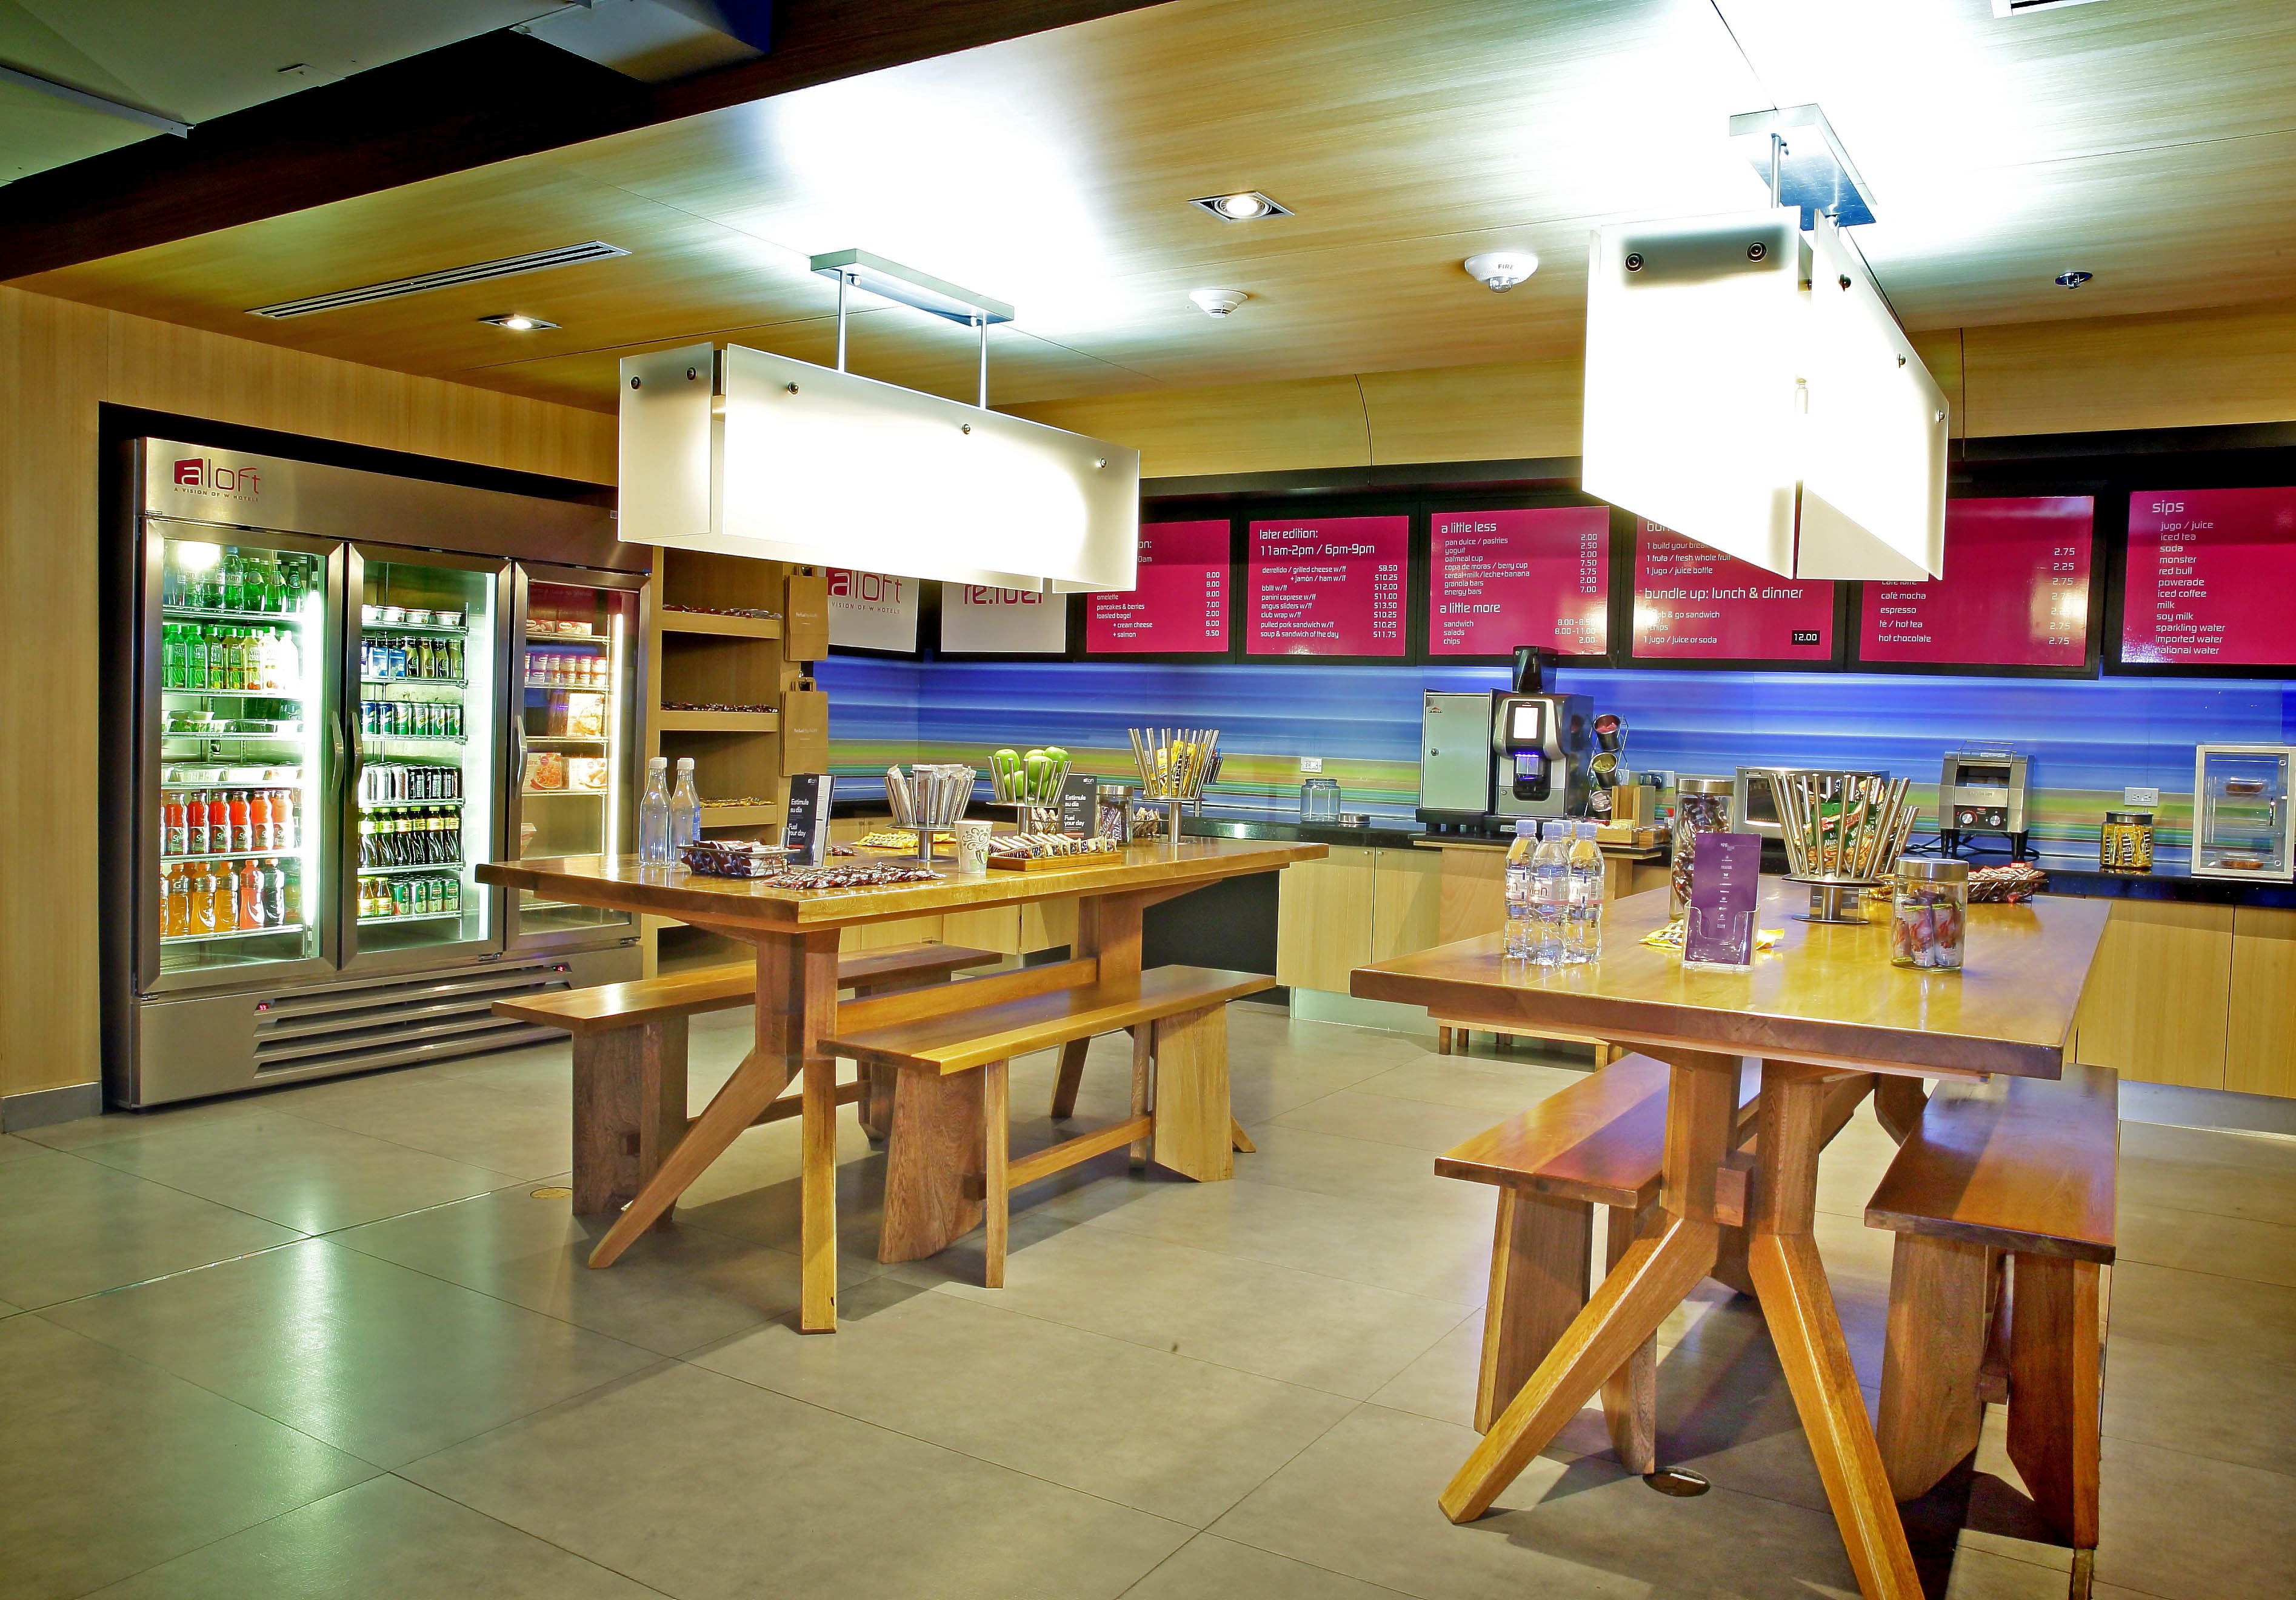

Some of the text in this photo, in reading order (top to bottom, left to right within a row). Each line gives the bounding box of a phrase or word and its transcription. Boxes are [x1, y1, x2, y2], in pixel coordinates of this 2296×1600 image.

[174, 458, 260, 494] aloft
[2152, 500, 2184, 515] sips
[1451, 522, 1472, 533] little
[1475, 521, 1496, 532] less
[2160, 521, 2213, 532] jugo juice
[1260, 528, 1318, 540] later edition:
[1261, 544, 1375, 557] 11am-2pm 6pm-9pm
[1446, 547, 1465, 555] yogurt
[1651, 567, 1667, 576] jugo
[2158, 578, 2204, 588] powerade
[1645, 587, 1803, 601] bundle up: lunch dinner
[832, 601, 854, 610] VISION
[1450, 602, 1470, 613] little
[1473, 604, 1500, 613] more
[2156, 624, 2197, 633] sparkling
[1649, 636, 1664, 644] jugo
[1672, 636, 1689, 644] juice
[2156, 635, 2194, 644] imported
[2155, 646, 2191, 655] national
